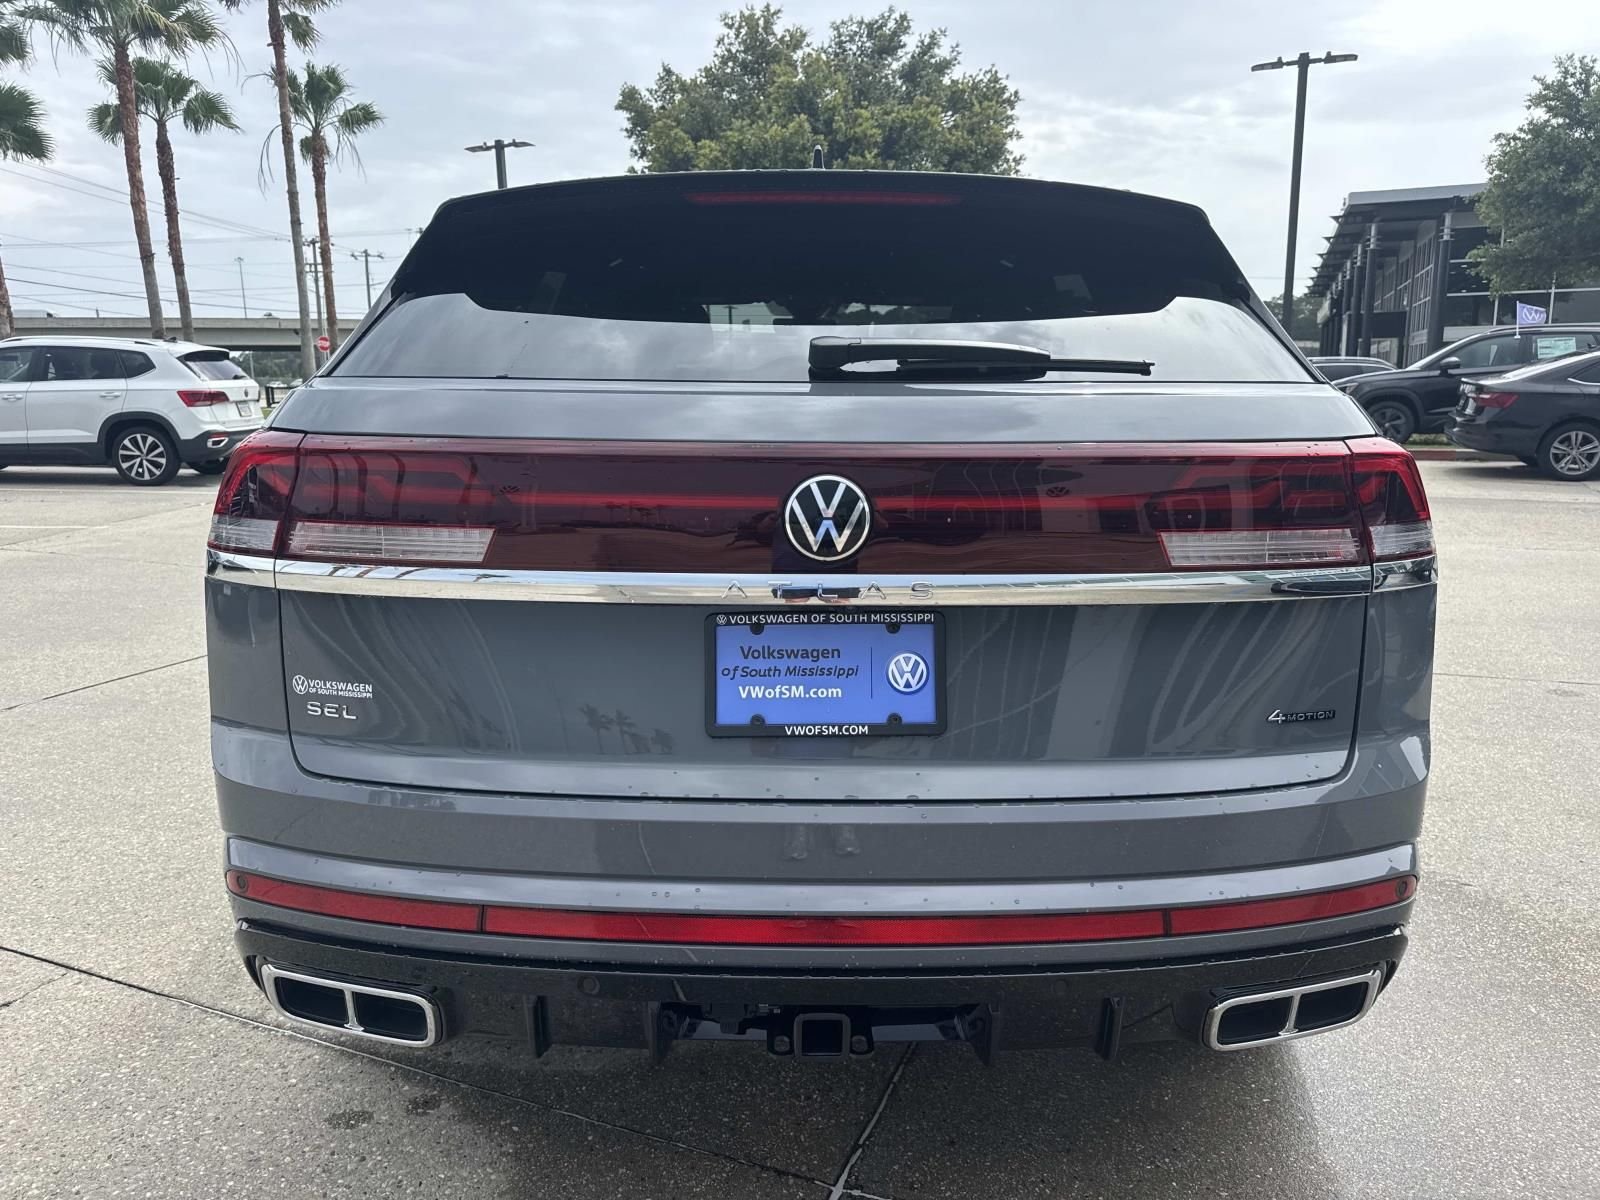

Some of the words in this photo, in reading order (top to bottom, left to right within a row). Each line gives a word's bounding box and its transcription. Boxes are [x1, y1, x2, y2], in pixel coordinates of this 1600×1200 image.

[788, 477, 868, 556] VW
[721, 581, 934, 600] ATLAS
[729, 614, 808, 624] VOLKSWAGEN
[811, 614, 826, 623] OF
[829, 613, 868, 622] SOUTH
[871, 613, 935, 623] MISSISSIPPI
[740, 645, 841, 662] Volkswagen
[721, 665, 739, 680] of
[740, 666, 781, 677] South
[784, 665, 859, 678] Mississippi
[889, 653, 927, 692] VW
[293, 675, 308, 694] VW
[309, 679, 372, 692] VOLKSWAGEN
[738, 685, 842, 698] VWofSM.com
[307, 701, 356, 720] SEL
[785, 725, 869, 735] VWOFSM.COM
